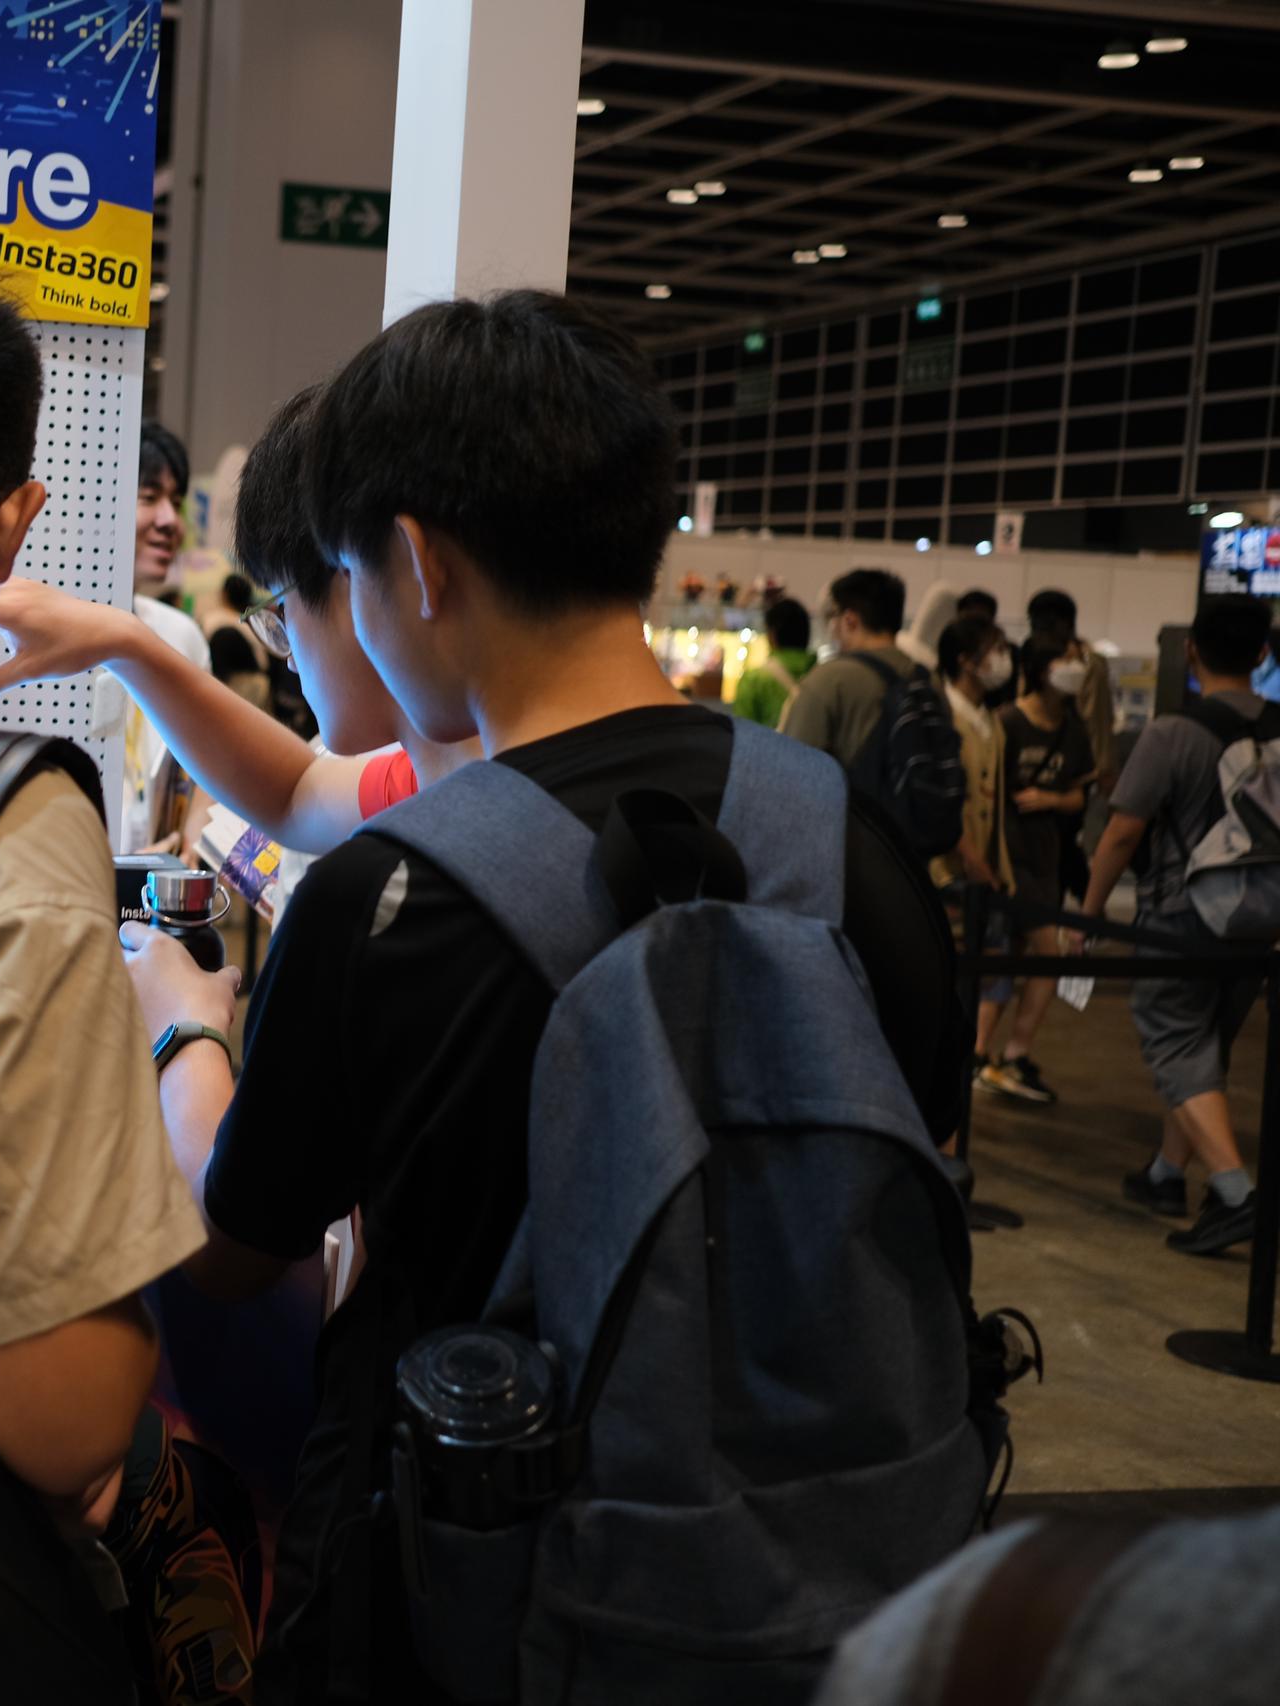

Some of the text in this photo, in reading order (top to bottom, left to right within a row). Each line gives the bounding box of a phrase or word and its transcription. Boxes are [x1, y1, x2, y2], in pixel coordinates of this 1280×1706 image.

[40, 285, 132, 318] Think bold.
[121, 906, 151, 919] Insta
